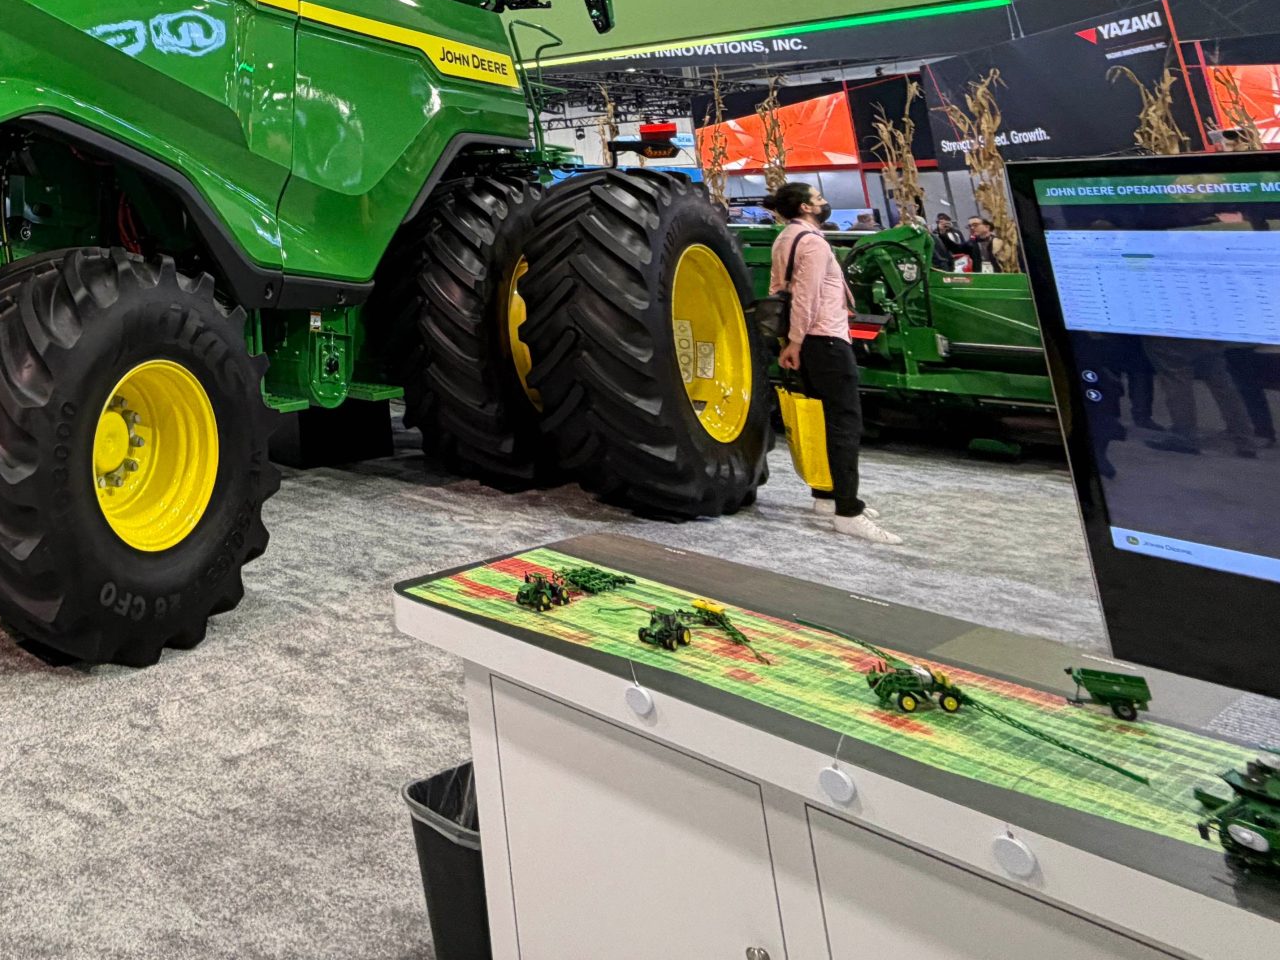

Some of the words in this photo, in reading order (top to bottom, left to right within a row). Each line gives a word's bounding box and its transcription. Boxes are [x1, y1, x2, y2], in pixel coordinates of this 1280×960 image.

[1097, 11, 1162, 40] YAZAKI
[773, 38, 808, 52] INC.
[439, 46, 470, 68] JOHN
[471, 53, 508, 76] DEERE
[1010, 127, 1051, 144] Growth.
[1045, 187, 1076, 197] JOHN
[1077, 186, 1115, 196] DEERE
[1116, 184, 1195, 196] OPERATIONS
